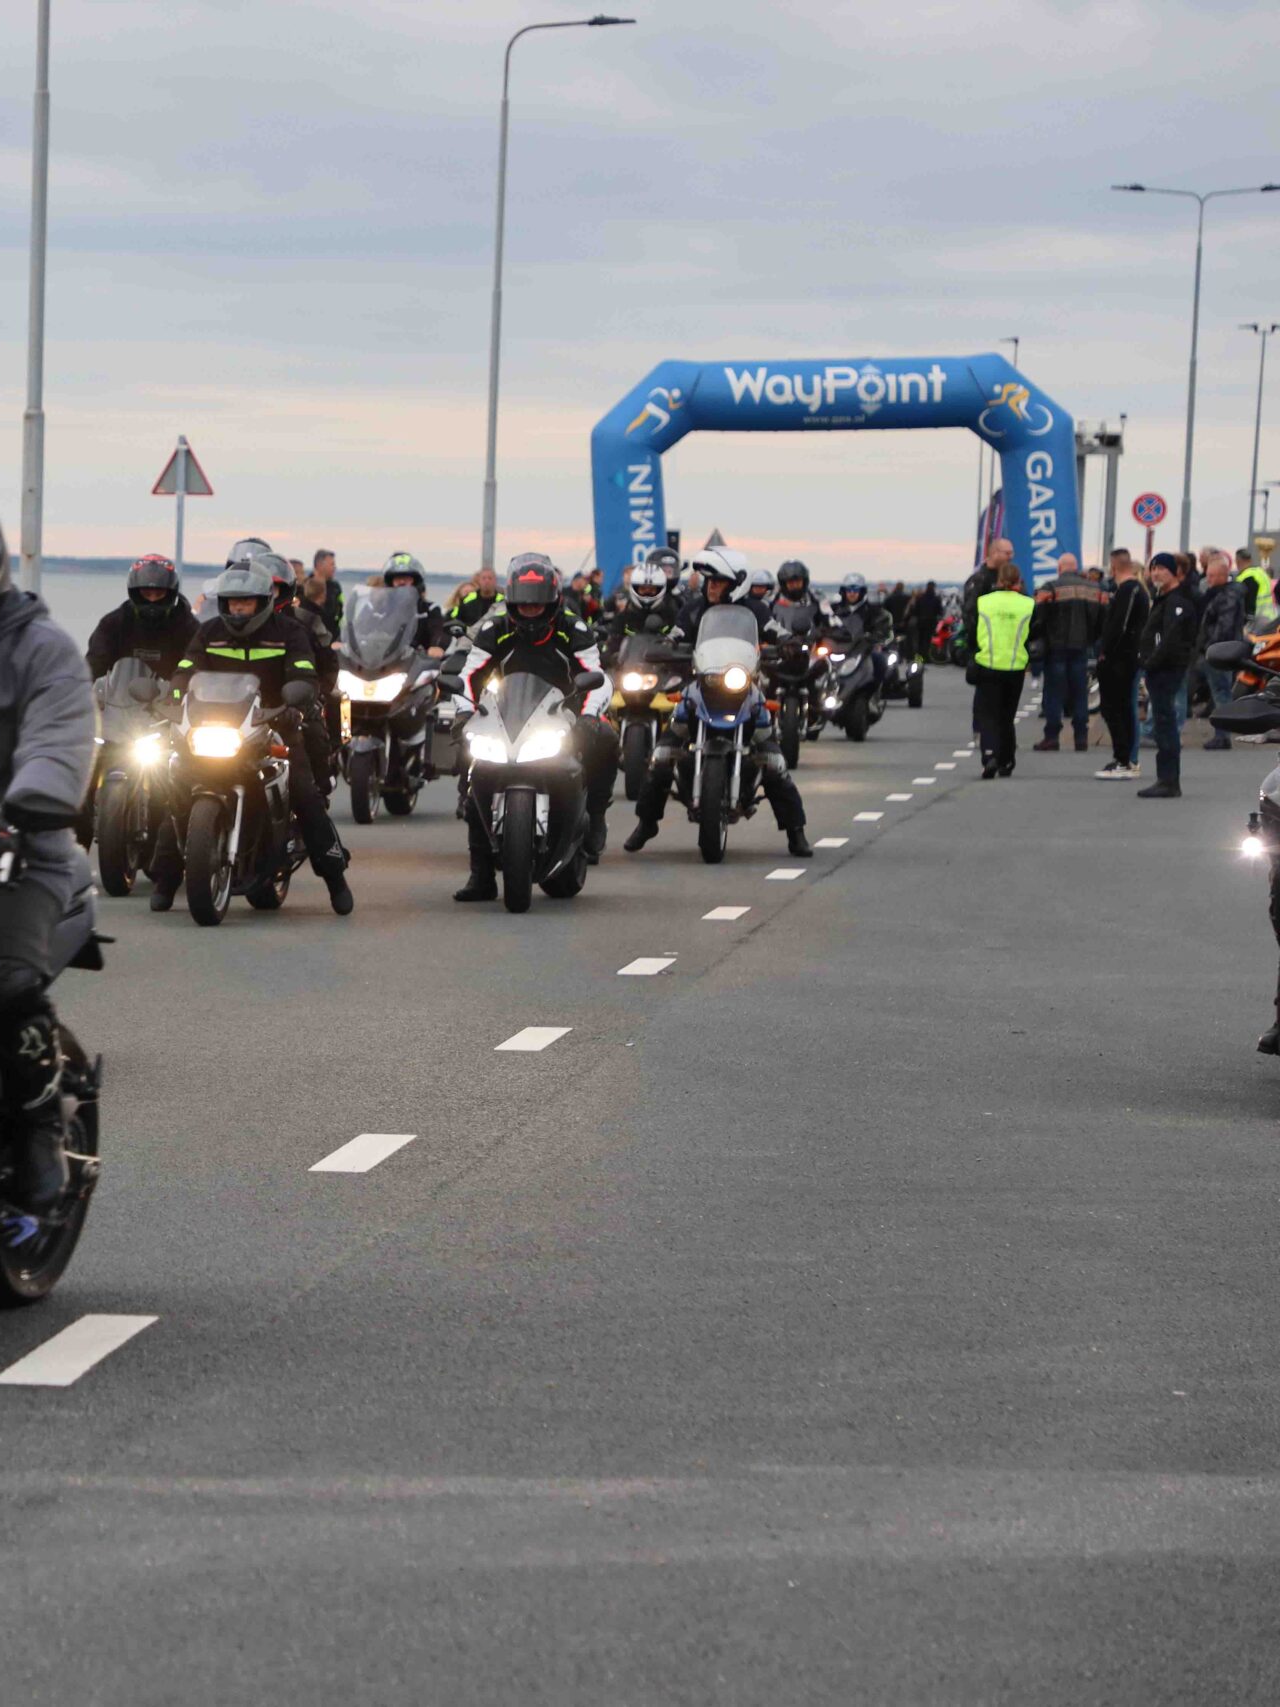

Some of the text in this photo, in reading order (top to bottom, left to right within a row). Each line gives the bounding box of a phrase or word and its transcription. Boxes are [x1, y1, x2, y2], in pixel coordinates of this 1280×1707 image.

[724, 364, 947, 413] WayPoint
[627, 464, 657, 566] RMIN
[1025, 450, 1060, 590] GARMI
